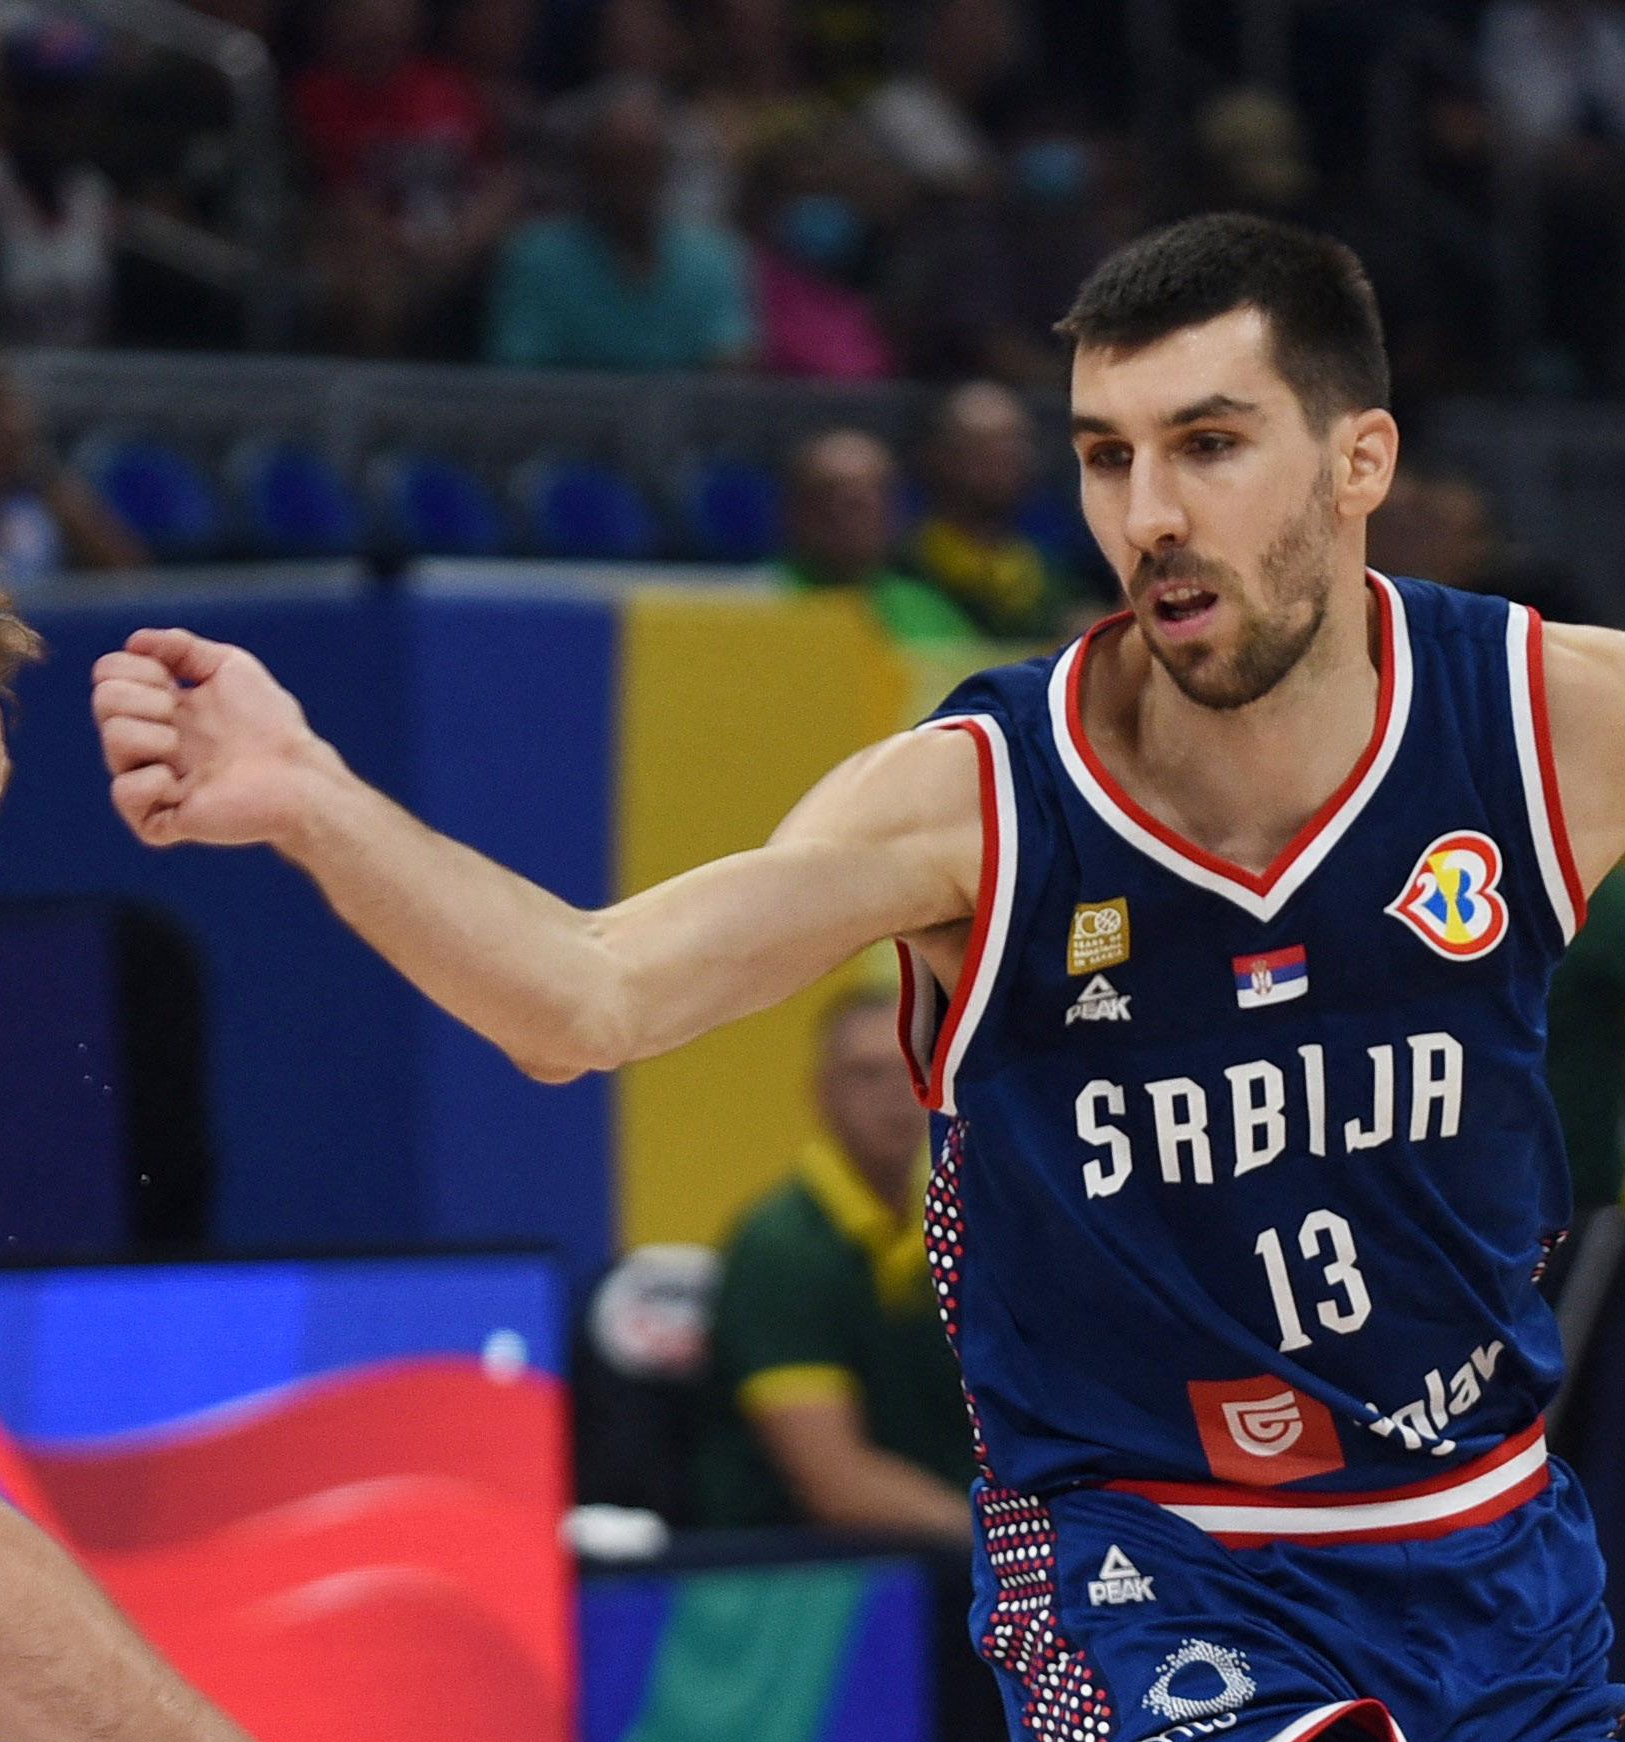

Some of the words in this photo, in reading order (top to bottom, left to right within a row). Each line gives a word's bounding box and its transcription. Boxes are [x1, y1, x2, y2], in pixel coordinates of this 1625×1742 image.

[1065, 994, 1132, 1026] PEAK
[1075, 1031, 1464, 1199] SRBIJA
[1254, 1208, 1372, 1353] 13
[1087, 1576, 1157, 1606] PEAK
